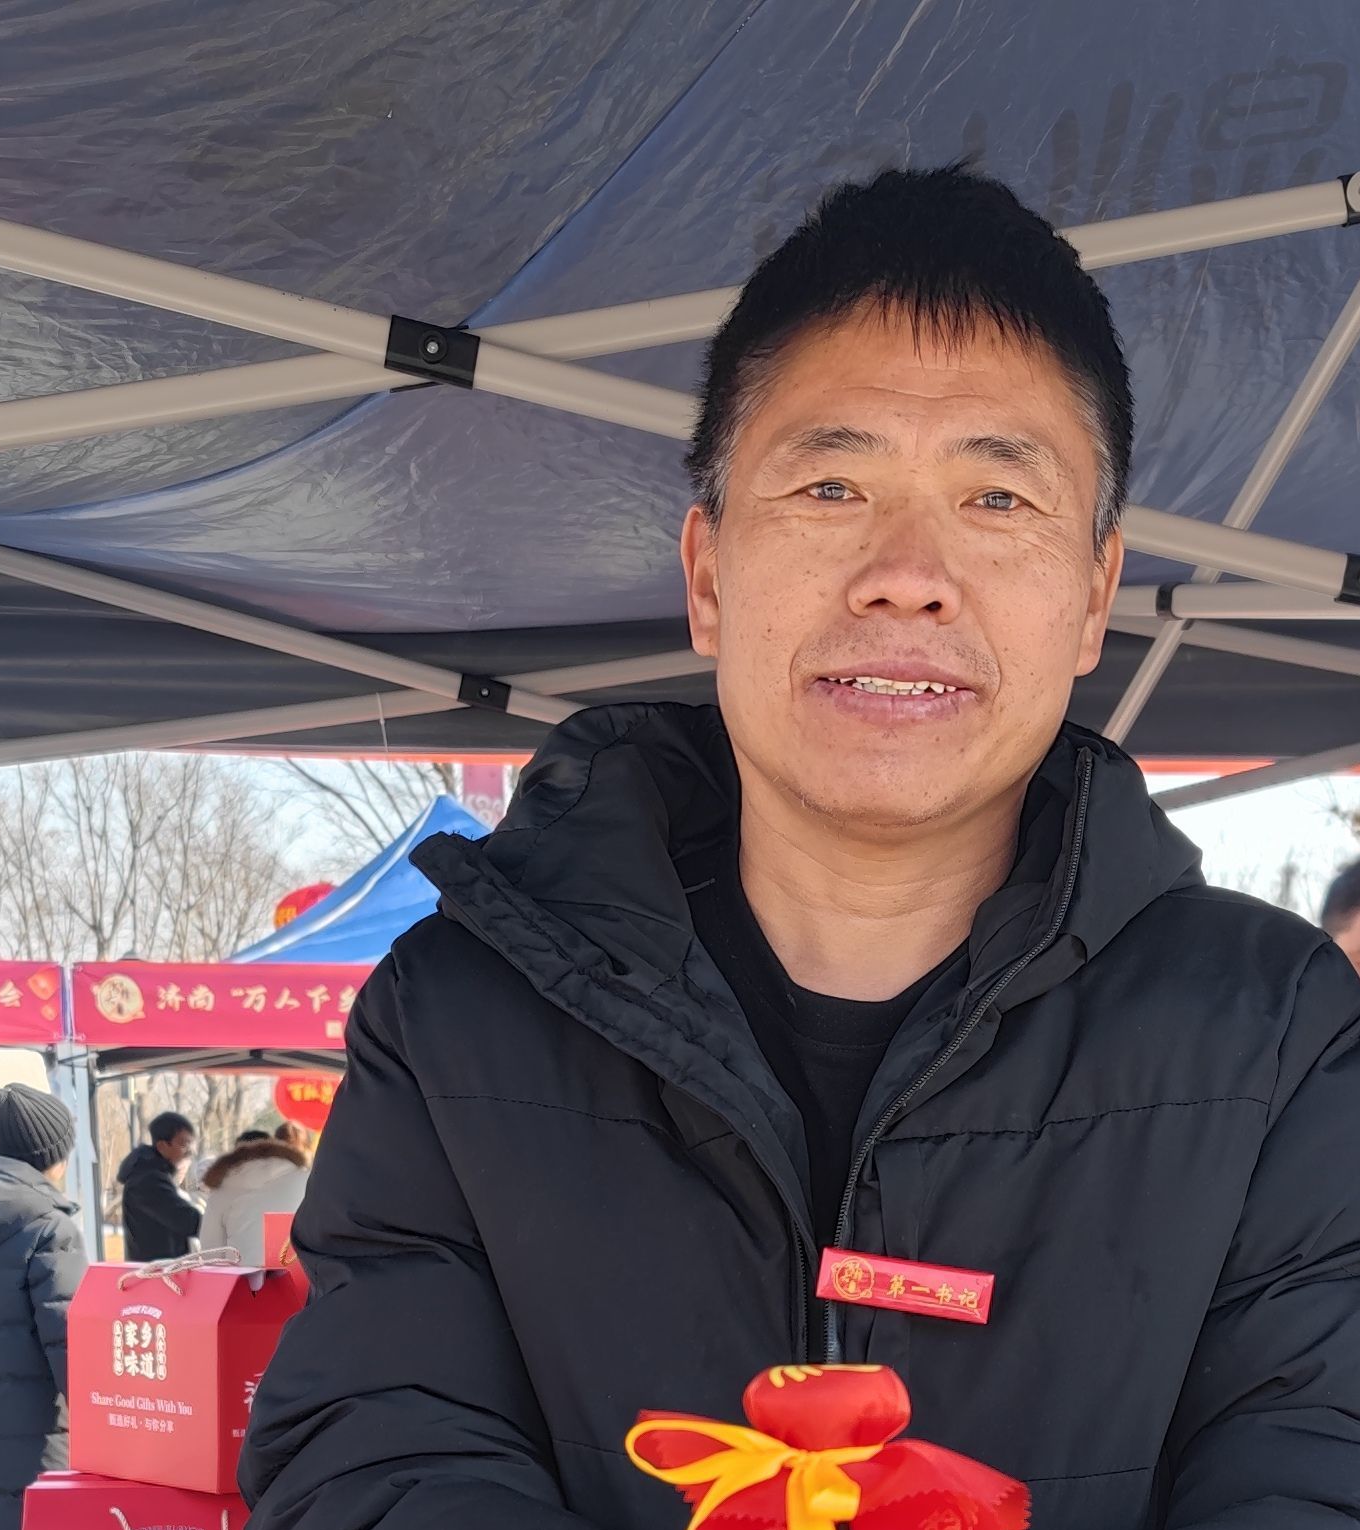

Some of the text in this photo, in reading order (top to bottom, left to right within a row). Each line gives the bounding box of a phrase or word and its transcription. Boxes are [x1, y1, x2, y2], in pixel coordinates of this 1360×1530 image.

[156, 983, 216, 1011] 济南
[886, 1273, 979, 1309] 第一书记
[124, 1319, 152, 1349] 家乡
[124, 1349, 156, 1380] 味道
[91, 1391, 194, 1416] Share Good Gifts With You
